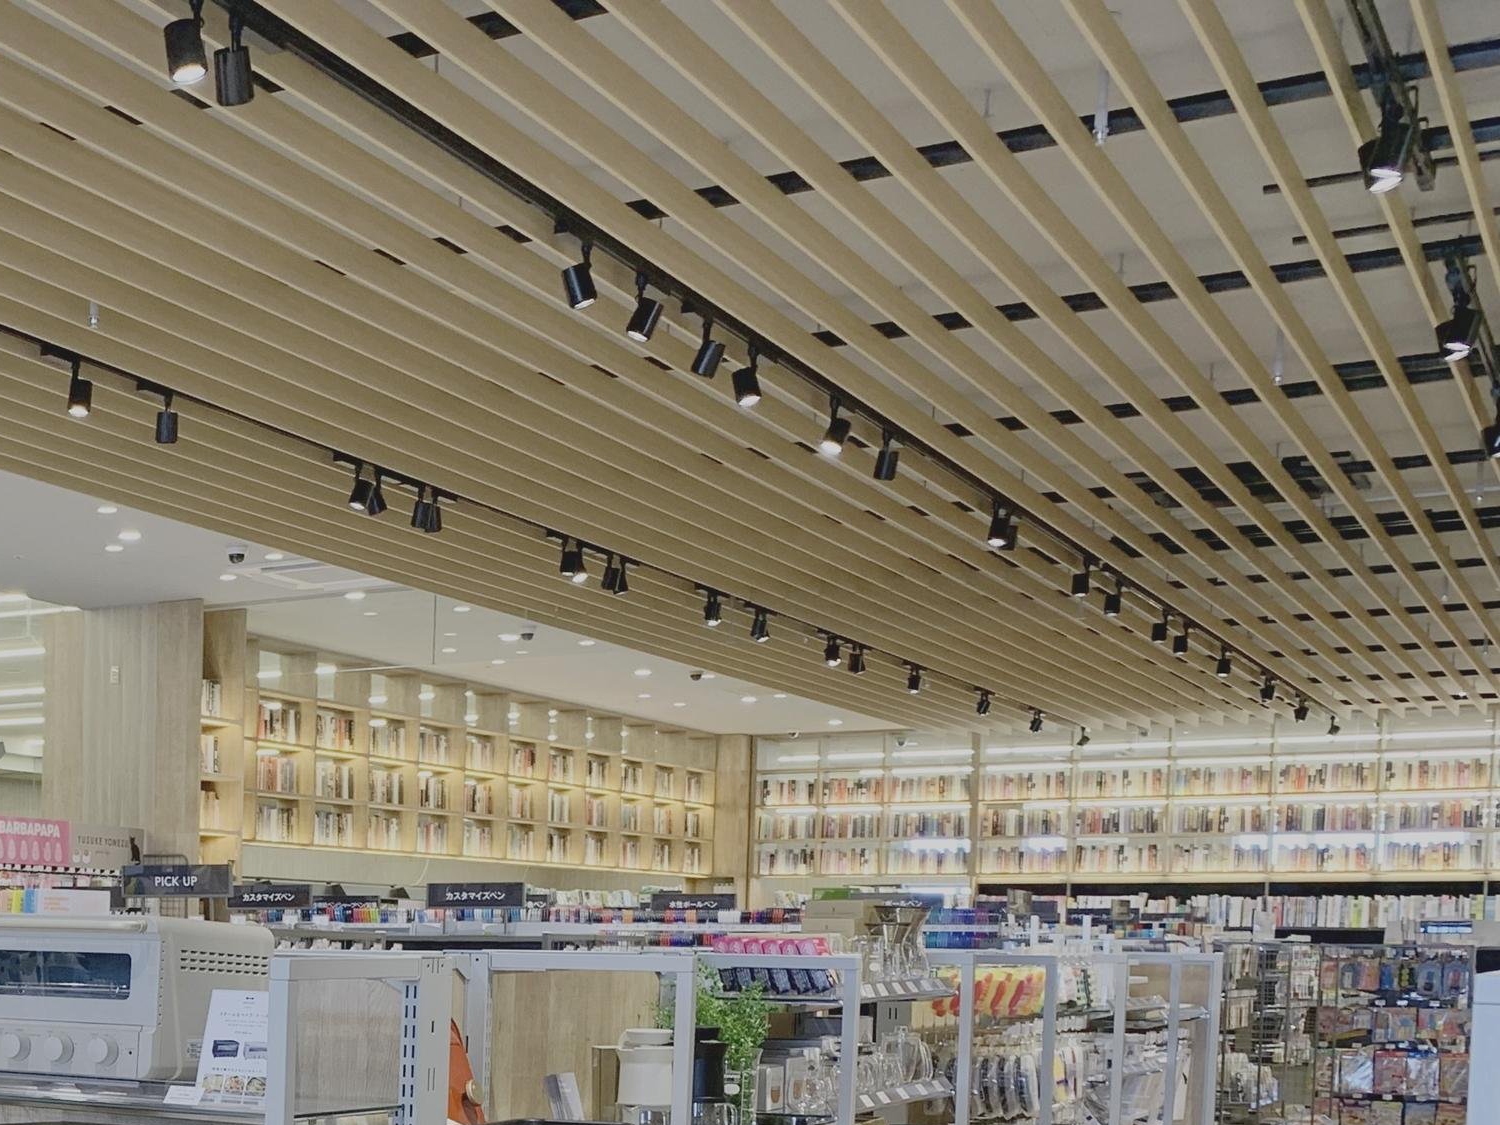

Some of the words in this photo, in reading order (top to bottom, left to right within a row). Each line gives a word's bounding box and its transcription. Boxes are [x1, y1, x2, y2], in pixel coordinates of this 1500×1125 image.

[154, 876, 179, 888] PICK
[182, 876, 198, 887] UP
[242, 892, 296, 902] カスタマイズペン
[445, 891, 506, 901] カスタマイズペン
